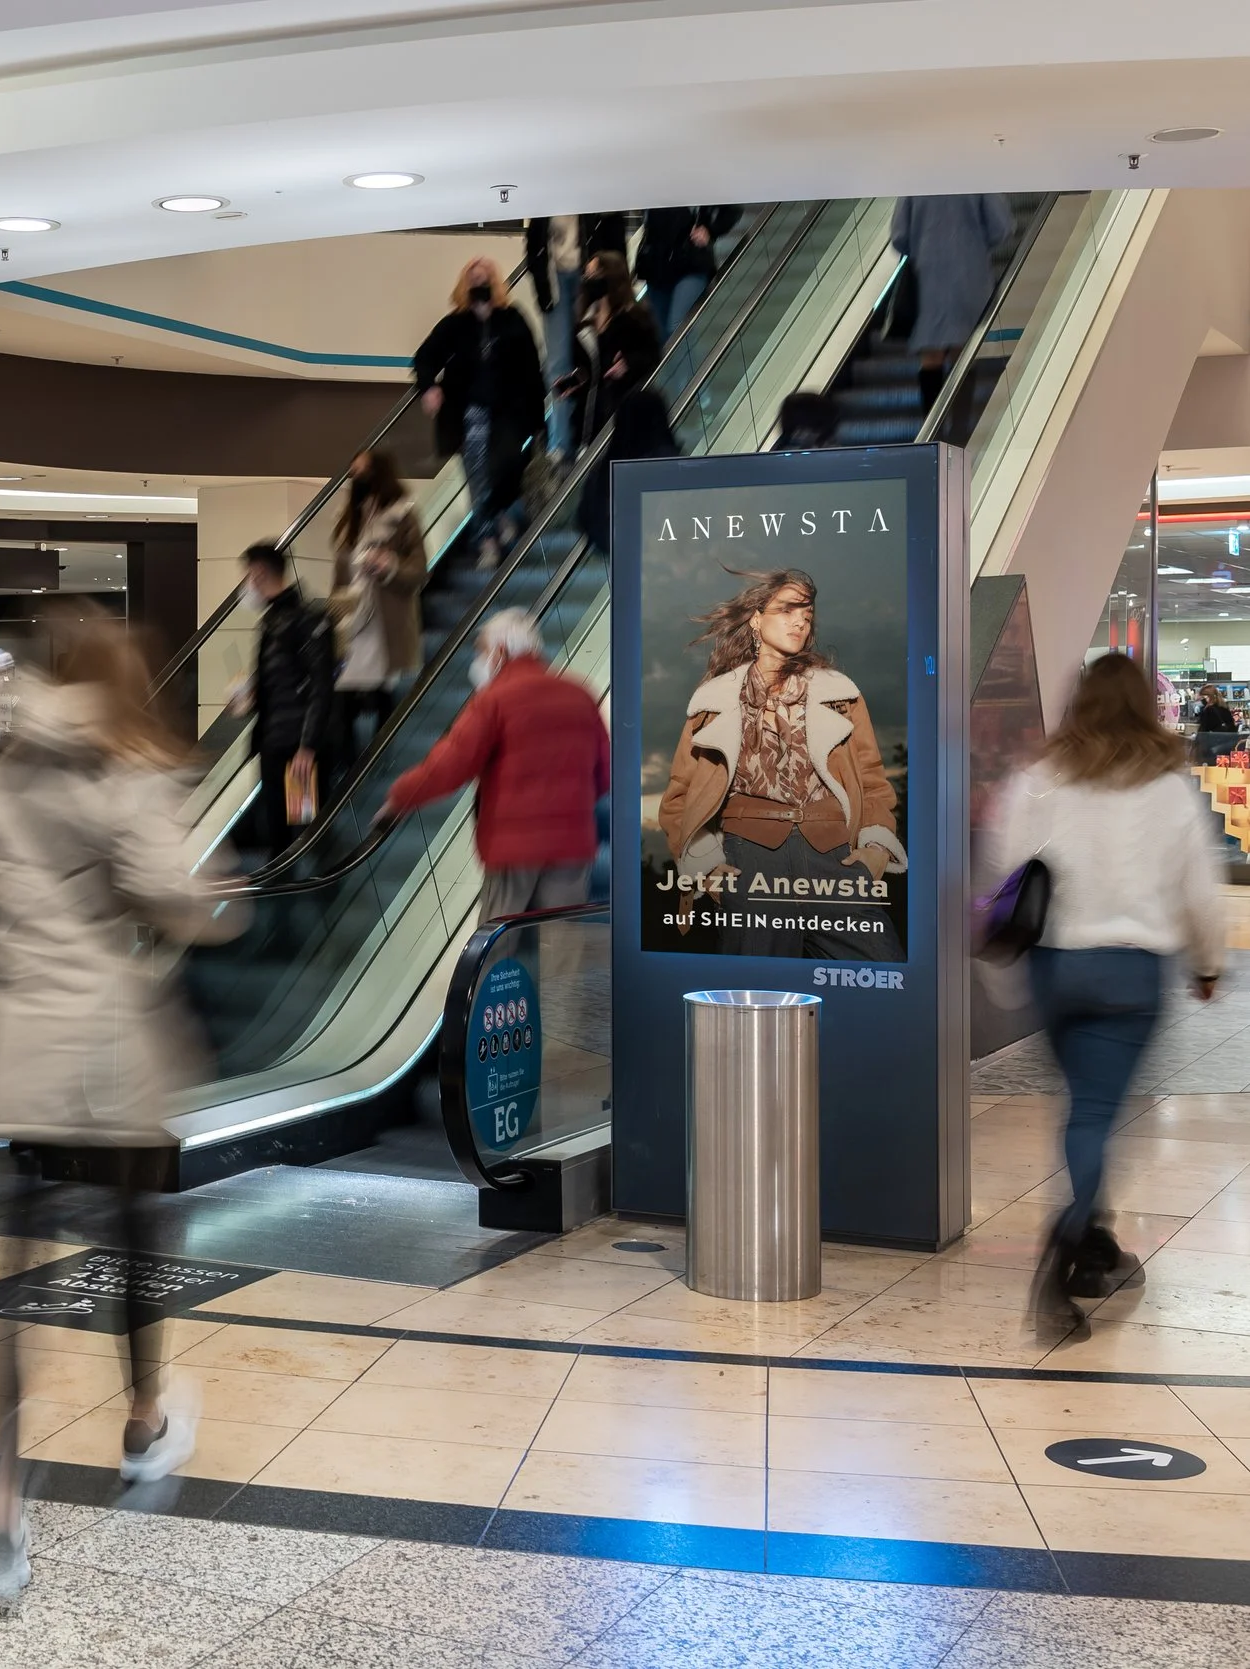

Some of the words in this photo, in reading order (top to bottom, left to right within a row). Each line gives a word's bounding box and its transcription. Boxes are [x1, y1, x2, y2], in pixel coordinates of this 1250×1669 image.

[656, 869, 738, 893] Jetzt
[748, 872, 889, 898] Anewsta
[663, 910, 696, 925] auf
[700, 911, 767, 929] SHEIN
[771, 915, 885, 933] entdecken
[812, 966, 905, 990] STRÖER
[494, 1101, 519, 1143] EG
[77, 1263, 120, 1273] Sie
[125, 1269, 215, 1285] mmer
[88, 1255, 153, 1267] Bite
[157, 1263, 240, 1280] lassen
[48, 1278, 170, 1299] Abstand
